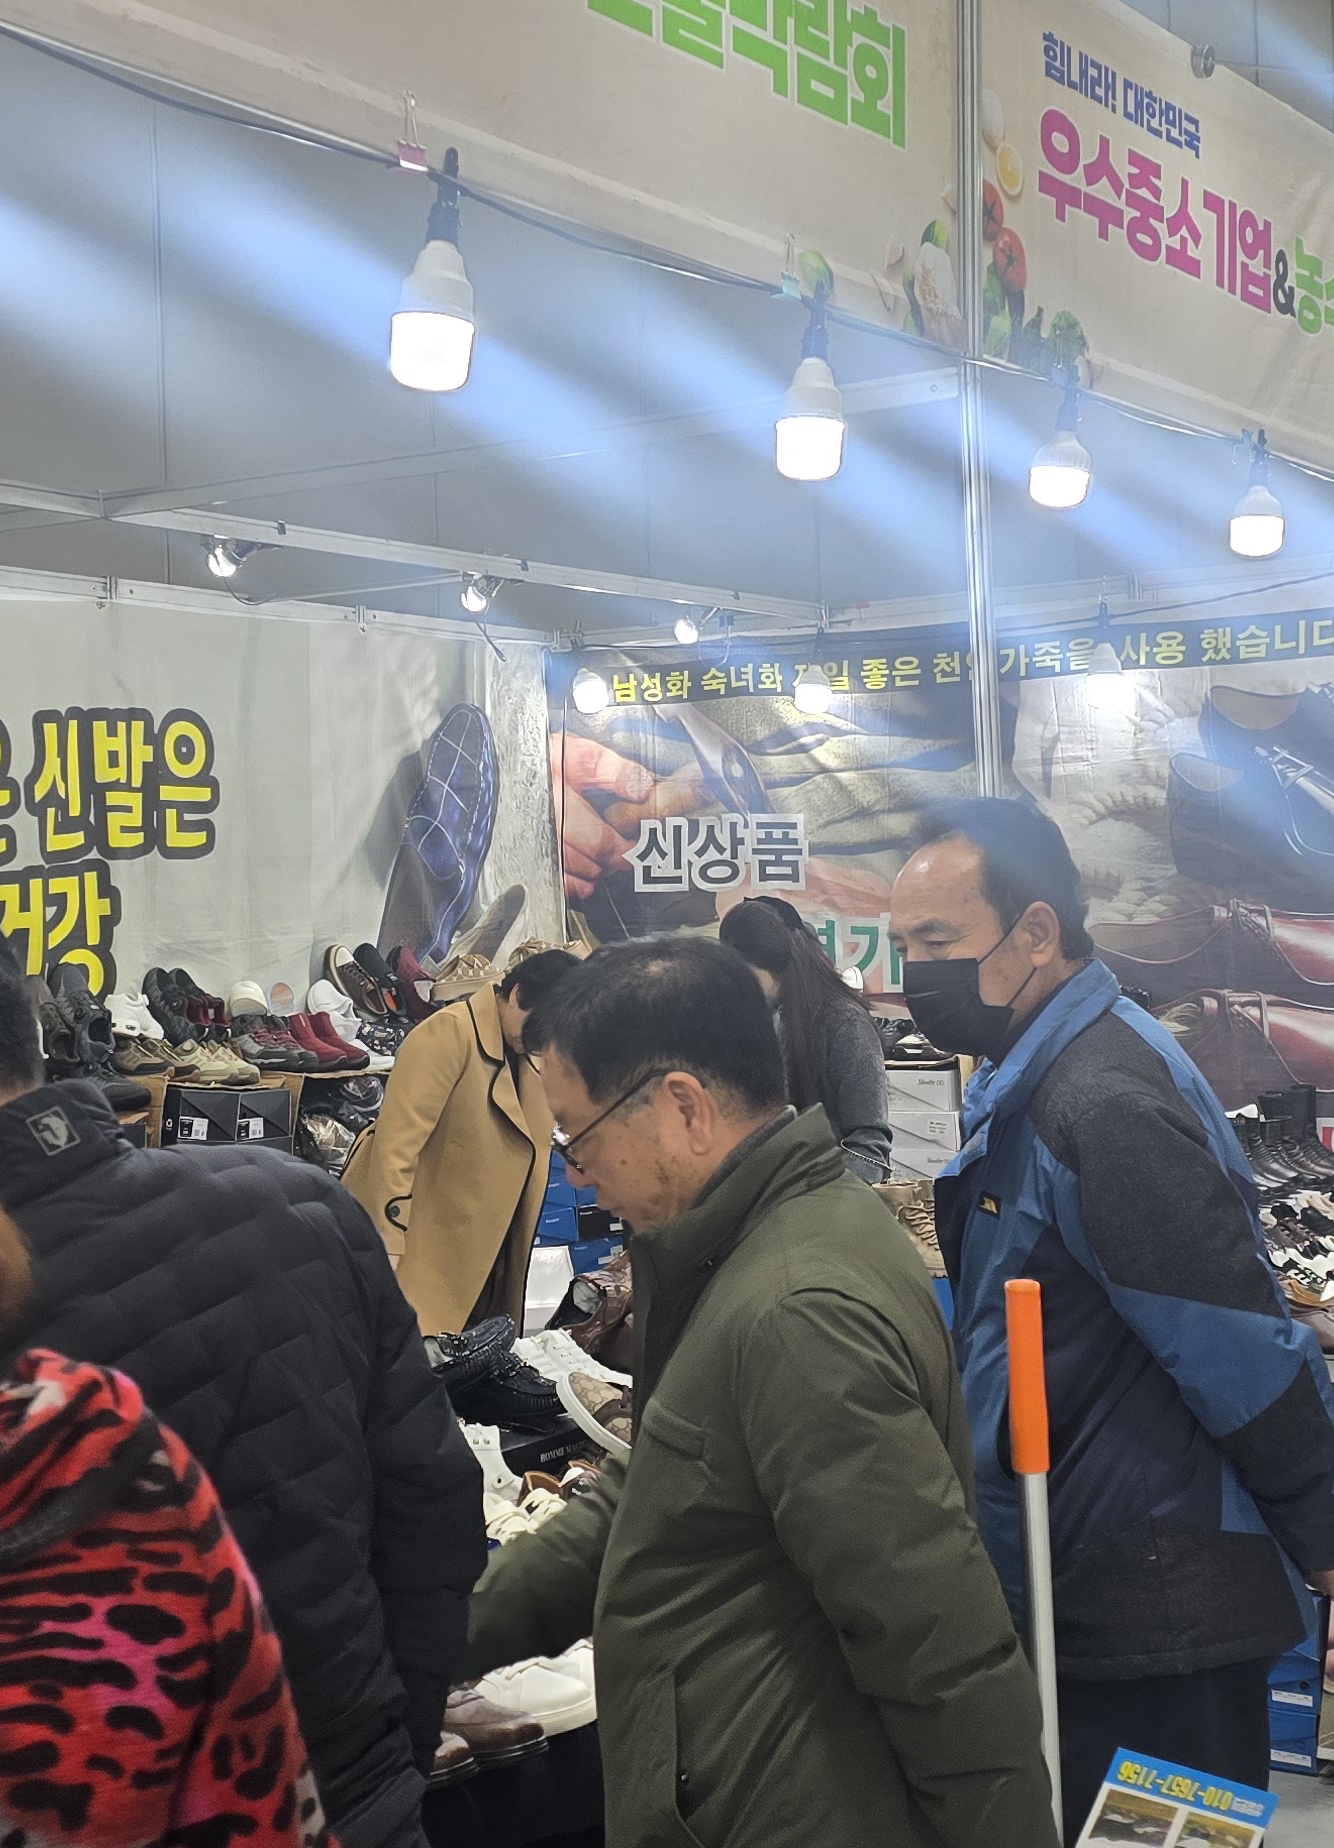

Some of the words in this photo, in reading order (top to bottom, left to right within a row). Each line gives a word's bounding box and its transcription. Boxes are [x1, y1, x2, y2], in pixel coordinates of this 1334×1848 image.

[1043, 31, 1117, 114] 힘내라!
[1122, 76, 1201, 160] 대한민국
[612, 669, 692, 703] 남성화
[701, 663, 783, 696] 숙녀화
[860, 657, 922, 690] 좋은
[999, 637, 1095, 677] 가죽을
[1119, 631, 1187, 667] 사용
[33, 718, 213, 854] 신발은
[633, 812, 807, 892] 신상품
